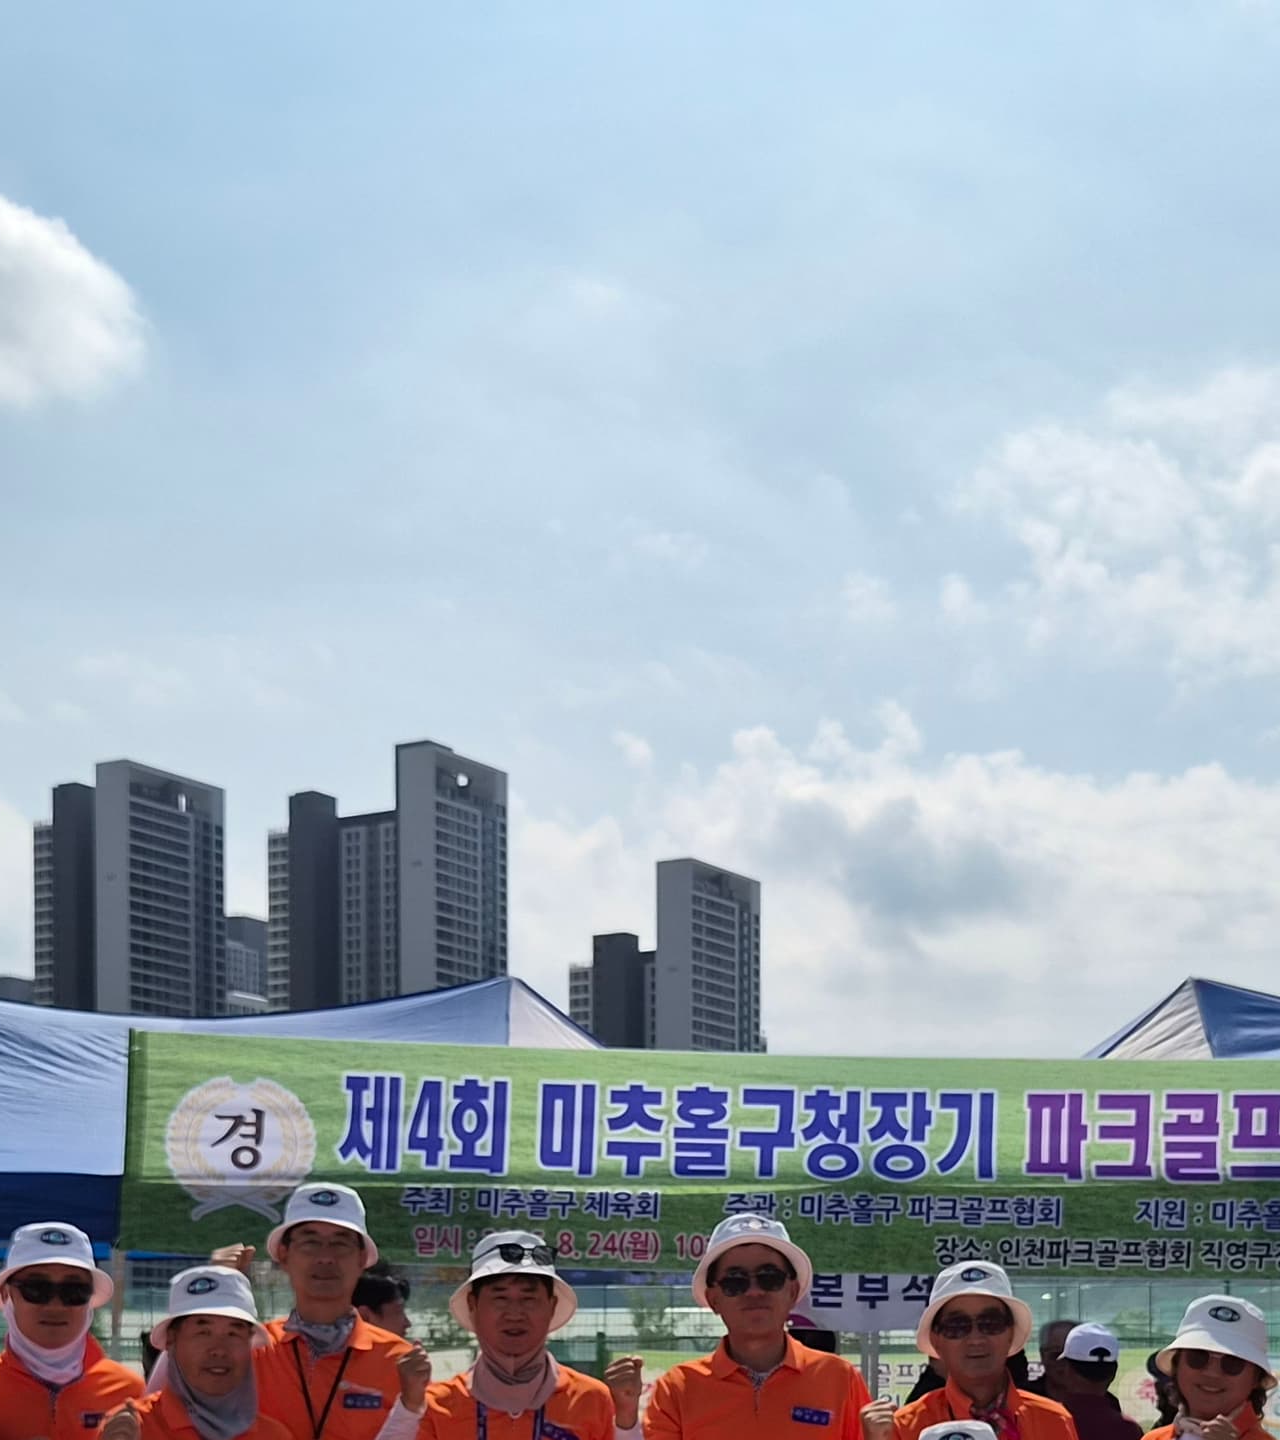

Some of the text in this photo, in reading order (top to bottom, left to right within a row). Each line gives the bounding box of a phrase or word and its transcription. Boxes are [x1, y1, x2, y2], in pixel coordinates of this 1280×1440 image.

[211, 1108, 266, 1171] 경
[338, 1075, 509, 1174] 제4회
[539, 1083, 996, 1180] 미추홀구청장기
[402, 1187, 452, 1215] 주최
[476, 1188, 577, 1218] 미추홀구
[584, 1191, 660, 1219] 체육회
[800, 1195, 901, 1224] 미추홀구
[908, 1196, 1063, 1226] 파크골프협회
[1136, 1199, 1187, 1229] 지원
[415, 1226, 461, 1255] 일시
[999, 1237, 1192, 1269] 인천파크골프협회
